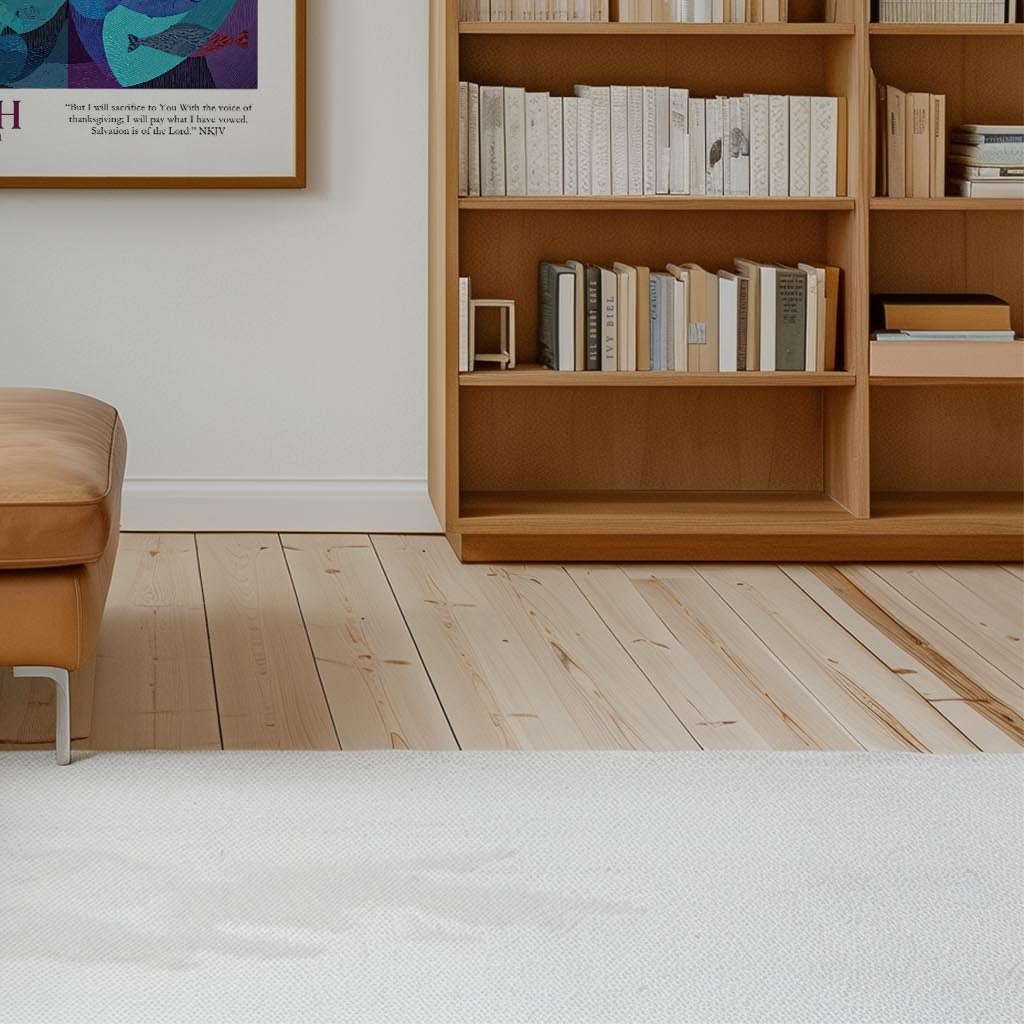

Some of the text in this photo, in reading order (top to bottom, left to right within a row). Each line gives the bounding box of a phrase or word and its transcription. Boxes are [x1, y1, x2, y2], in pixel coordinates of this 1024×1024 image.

[93, 103, 109, 112] will
[112, 103, 146, 112] sacrifice
[148, 104, 157, 112] to
[159, 103, 177, 112] You
[180, 103, 200, 112] With
[203, 103, 217, 112] the
[218, 103, 241, 112] voice
[243, 103, 253, 112] of
[127, 114, 131, 123] I
[133, 114, 148, 123] will
[150, 117, 165, 125] pay
[167, 114, 188, 123] what
[190, 114, 194, 123] I
[196, 114, 216, 123] have
[91, 126, 130, 136] Salvation
[132, 126, 139, 136] is
[141, 126, 152, 136] of
[153, 126, 167, 136] the
[199, 126, 226, 137] NKJV
[606, 296, 614, 359] IVY BIEL
[589, 343, 598, 361] ALL
